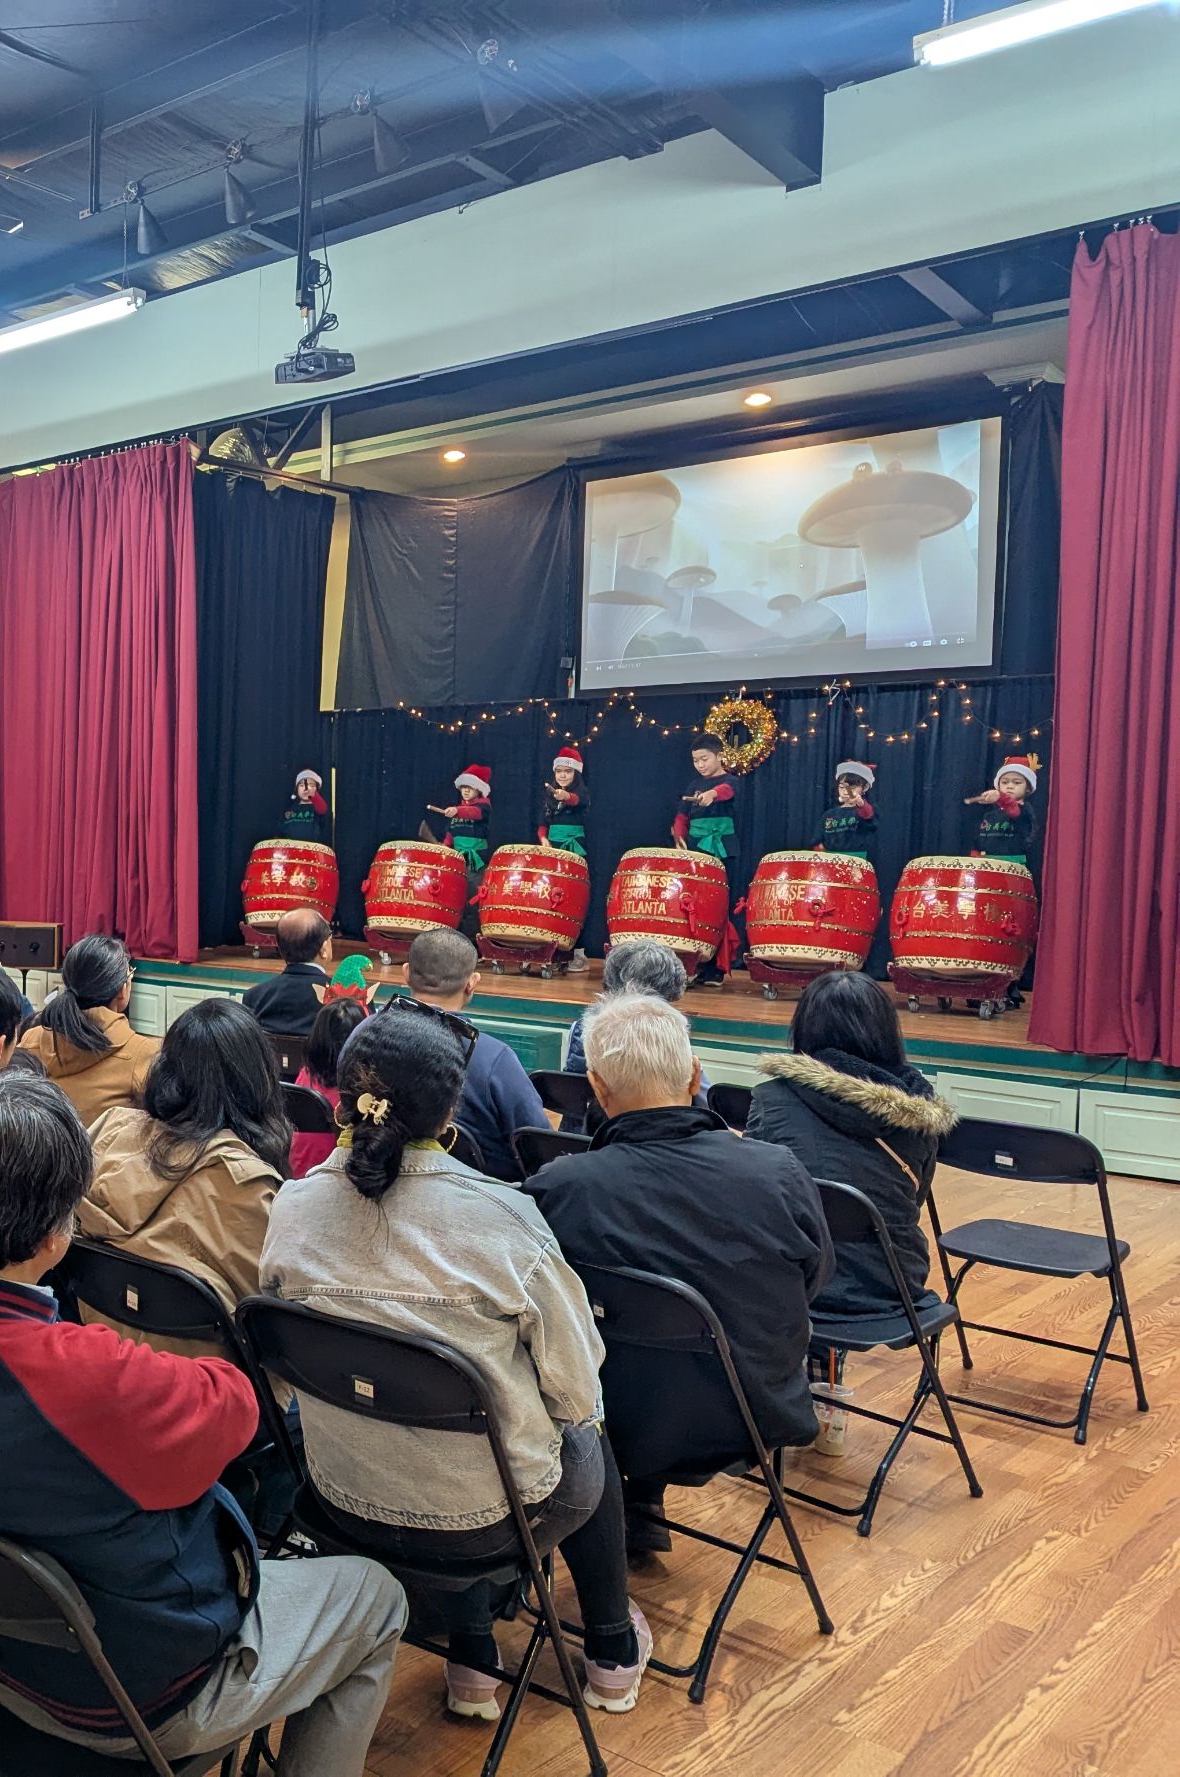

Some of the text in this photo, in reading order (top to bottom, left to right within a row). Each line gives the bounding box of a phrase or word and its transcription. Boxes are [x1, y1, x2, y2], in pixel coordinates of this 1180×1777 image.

[379, 865, 422, 879] IWANESE
[378, 876, 405, 888] HOOL
[622, 900, 667, 916] ATLANTA
[757, 907, 794, 920] LANTA
